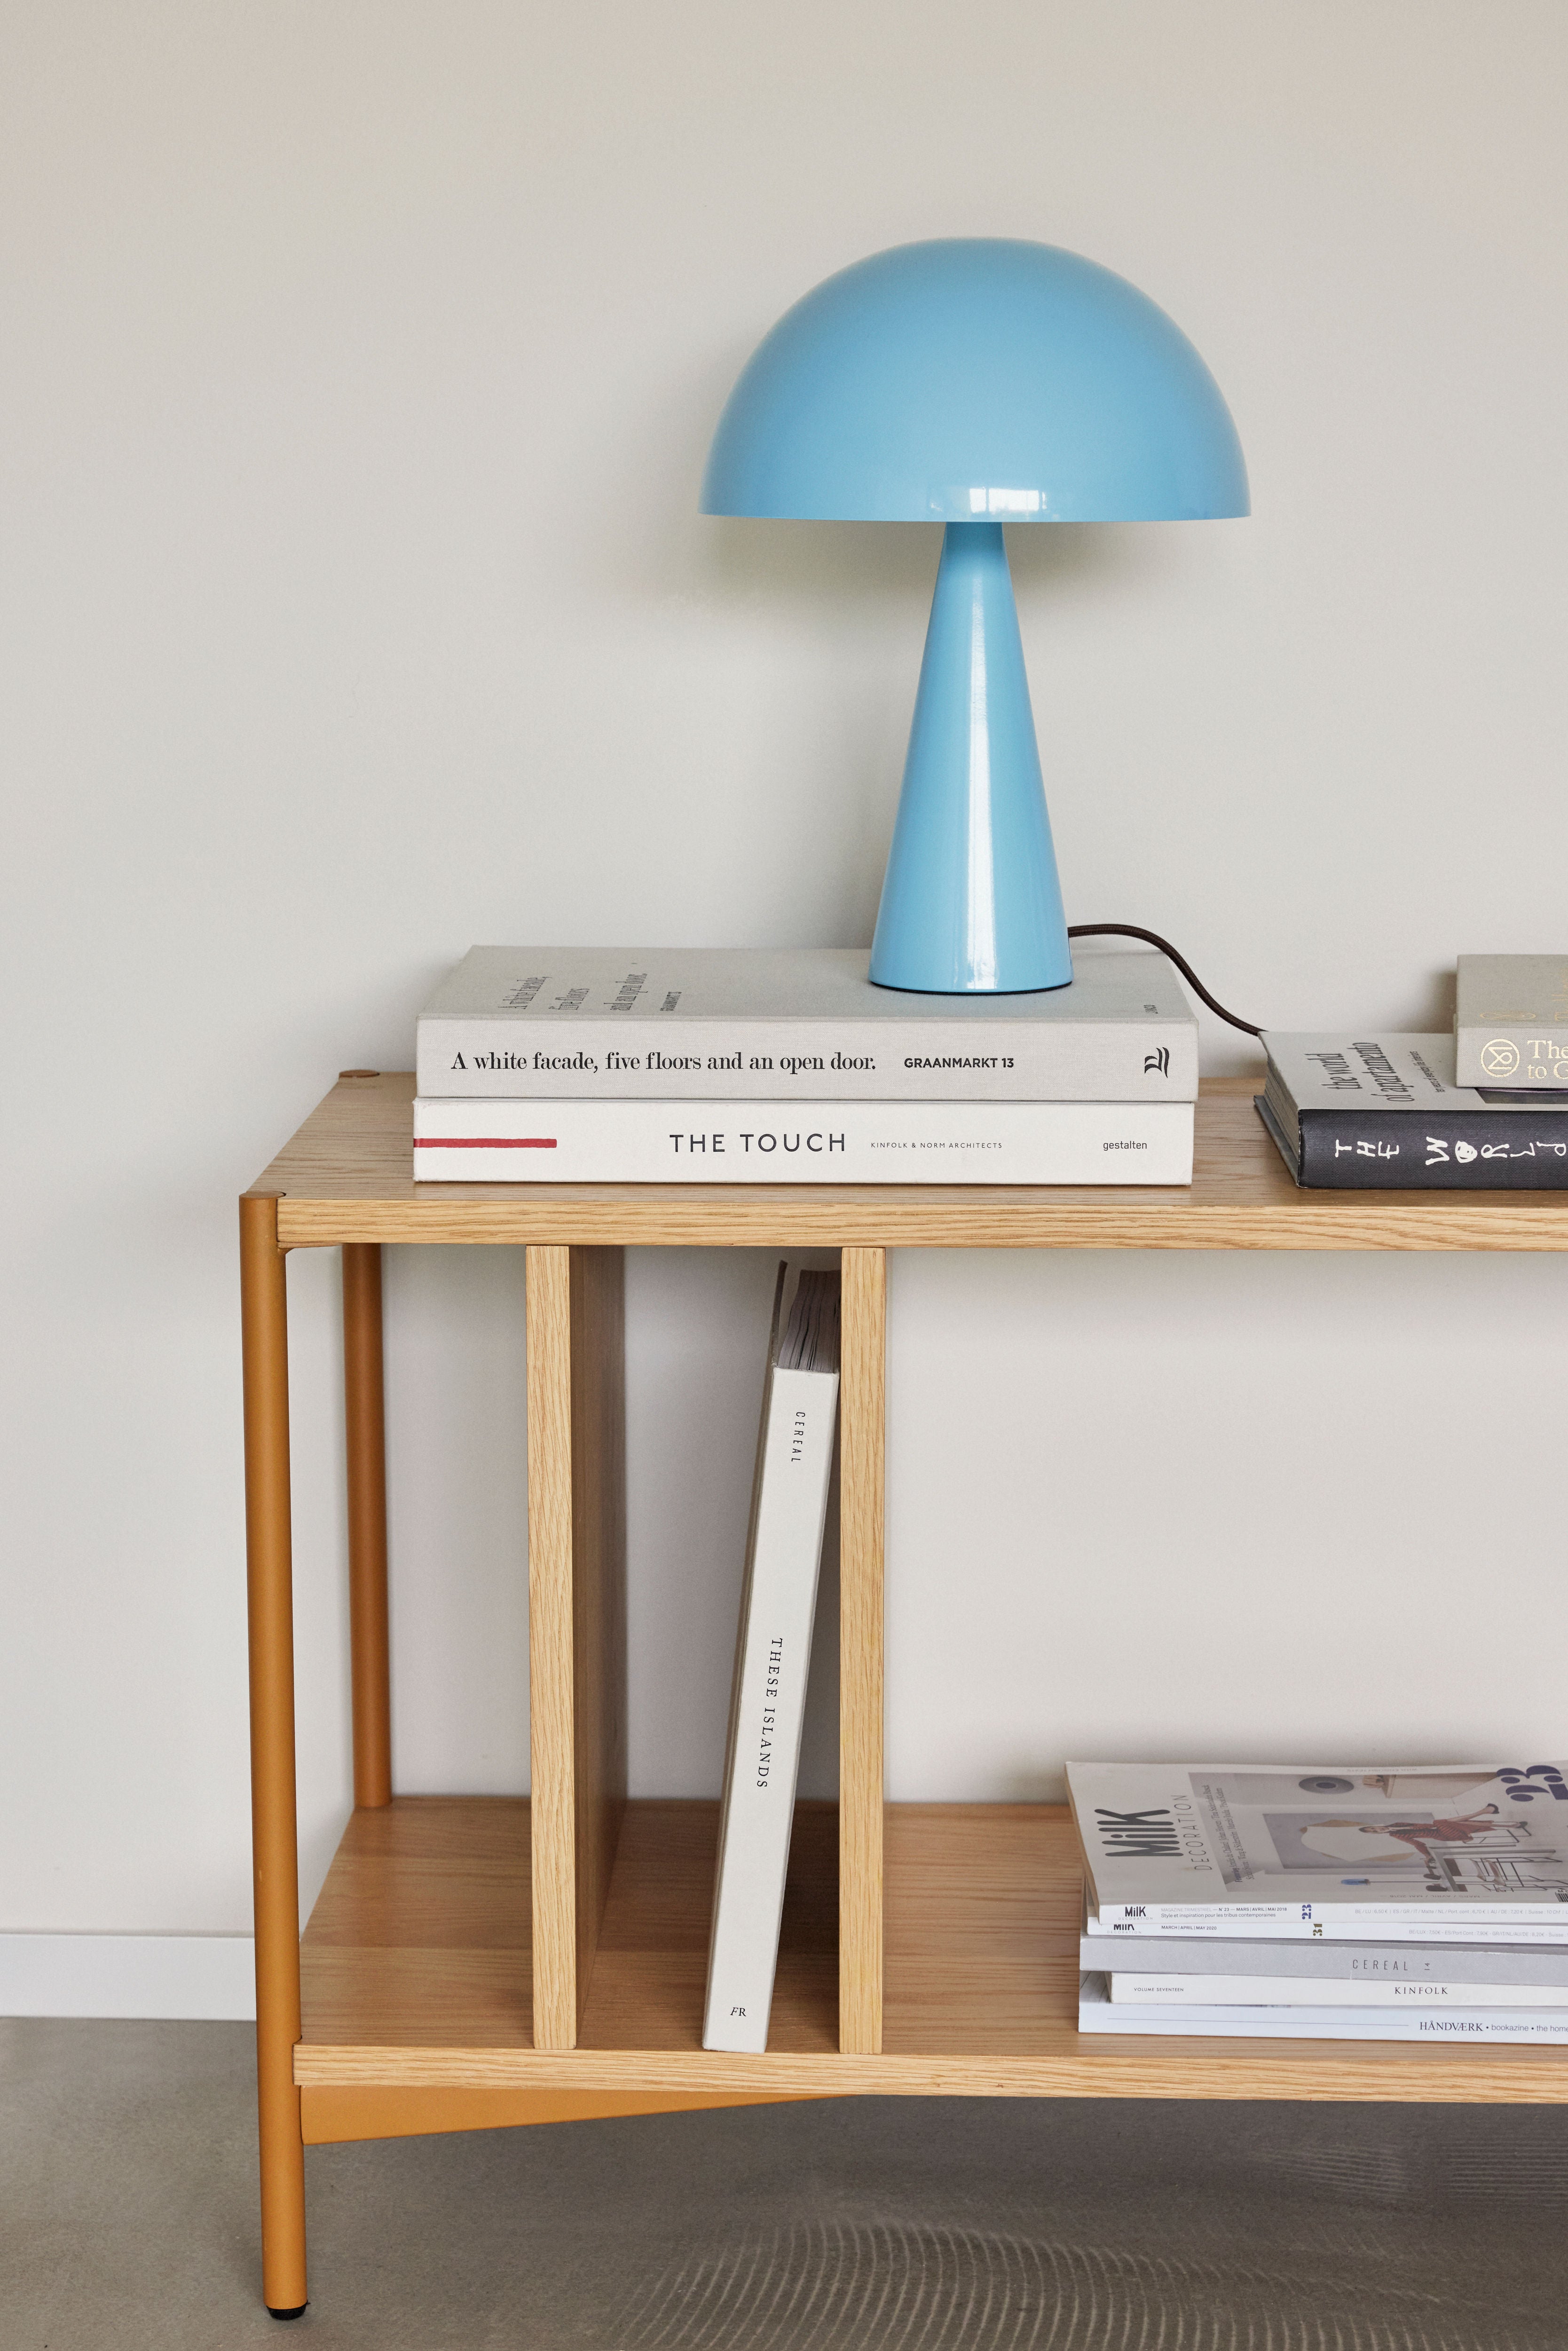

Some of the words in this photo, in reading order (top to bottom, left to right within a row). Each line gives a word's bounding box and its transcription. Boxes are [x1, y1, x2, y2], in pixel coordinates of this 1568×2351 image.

[450, 1052, 468, 1070] A
[473, 1051, 527, 1070] white
[532, 1051, 598, 1074] facade,
[605, 1051, 640, 1070] five
[646, 1051, 701, 1070] floors
[707, 1051, 744, 1070] and
[749, 1057, 774, 1070] an
[780, 1057, 825, 1075] open
[830, 1051, 876, 1070] door.
[904, 1057, 998, 1068] GRAANMARKT
[1001, 1057, 1014, 1068] 13
[1303, 1053, 1353, 1075] world
[1346, 1042, 1414, 1092] apartamento
[1527, 1065, 1548, 1080] to
[1320, 1076, 1363, 1089] the
[1371, 1093, 1415, 1102] of
[669, 1134, 725, 1152] THE
[740, 1133, 845, 1152] TOUCH
[1103, 1140, 1147, 1151] gestalten
[1335, 1139, 1399, 1159] THE
[791, 1412, 805, 1462] CEREAL
[766, 1638, 783, 1697] THESE
[756, 1707, 775, 1788] ISLANDS
[1497, 1765, 1568, 1802] 23
[1094, 1808, 1184, 1857] MilK
[1170, 1795, 1213, 1870] DECORATION
[1125, 1906, 1146, 1917] MilK
[1301, 1903, 1312, 1920] 23
[1313, 1923, 1323, 1936] 31
[1352, 1959, 1409, 1971] CEREAL
[730, 2007, 747, 2017] FR
[1419, 2020, 1484, 2031] HÅNDVÆRK
